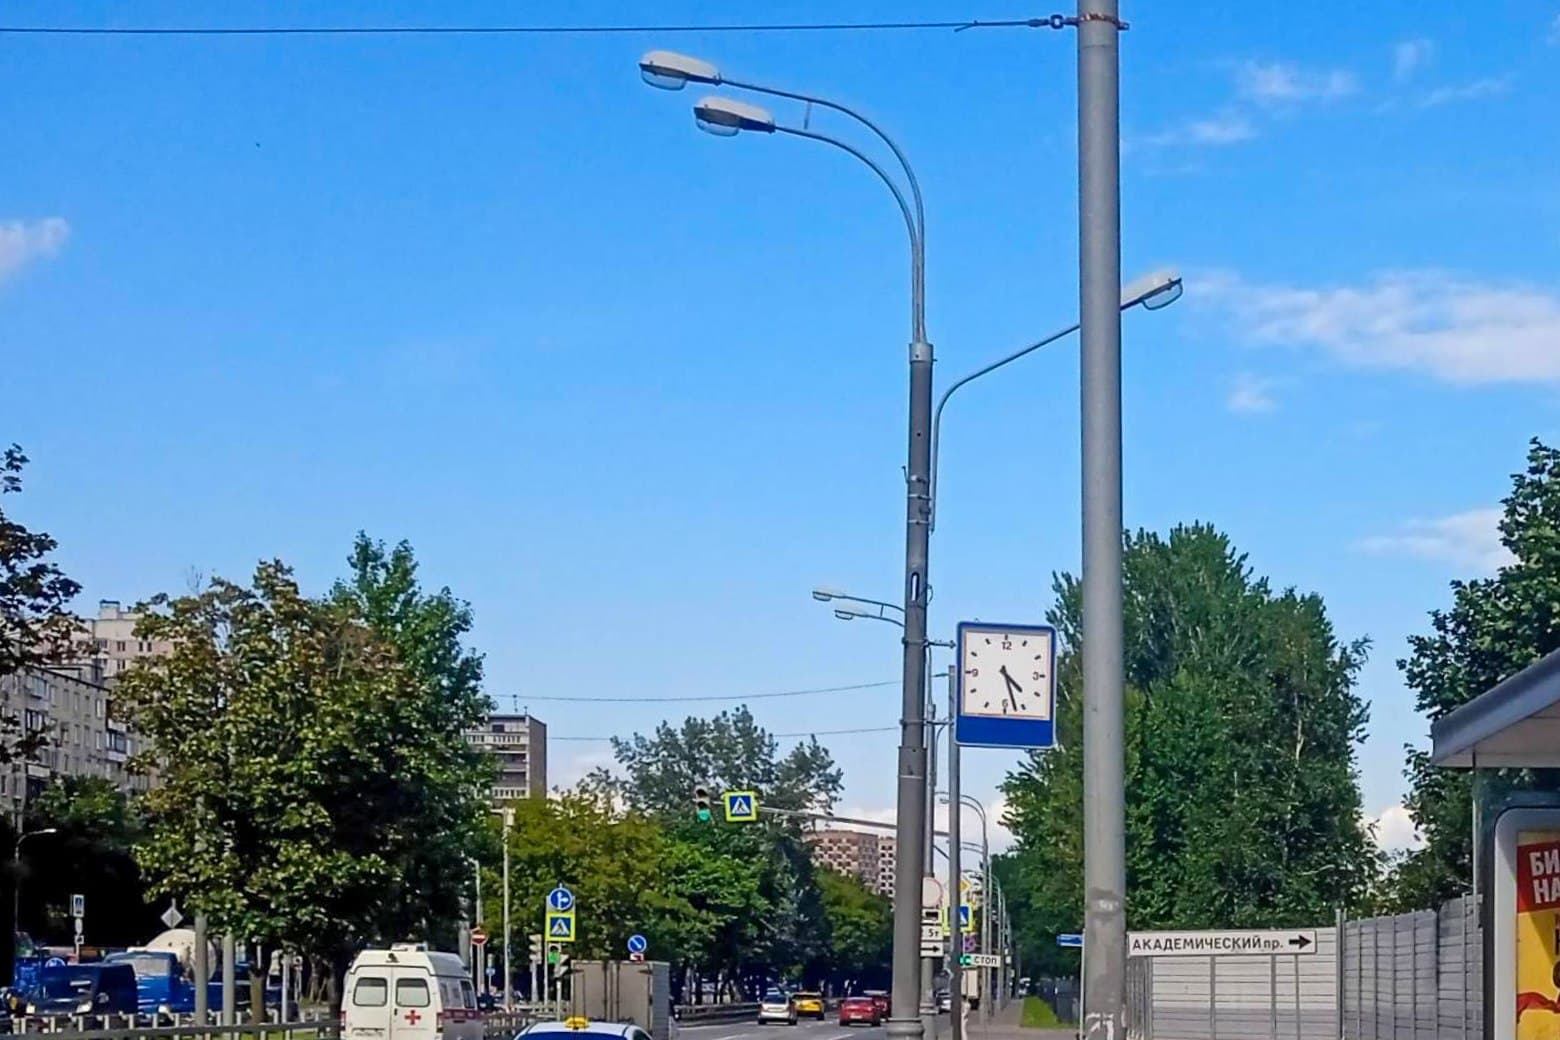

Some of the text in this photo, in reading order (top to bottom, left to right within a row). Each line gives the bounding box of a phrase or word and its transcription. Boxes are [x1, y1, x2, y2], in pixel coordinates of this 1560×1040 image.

[1001, 641, 1012, 651] 12
[971, 668, 979, 677] 9
[1032, 671, 1039, 681] 3
[1001, 698, 1009, 707] 6
[1132, 935, 1284, 951] АКАДЕМИЧЕСКИЙ пр.
